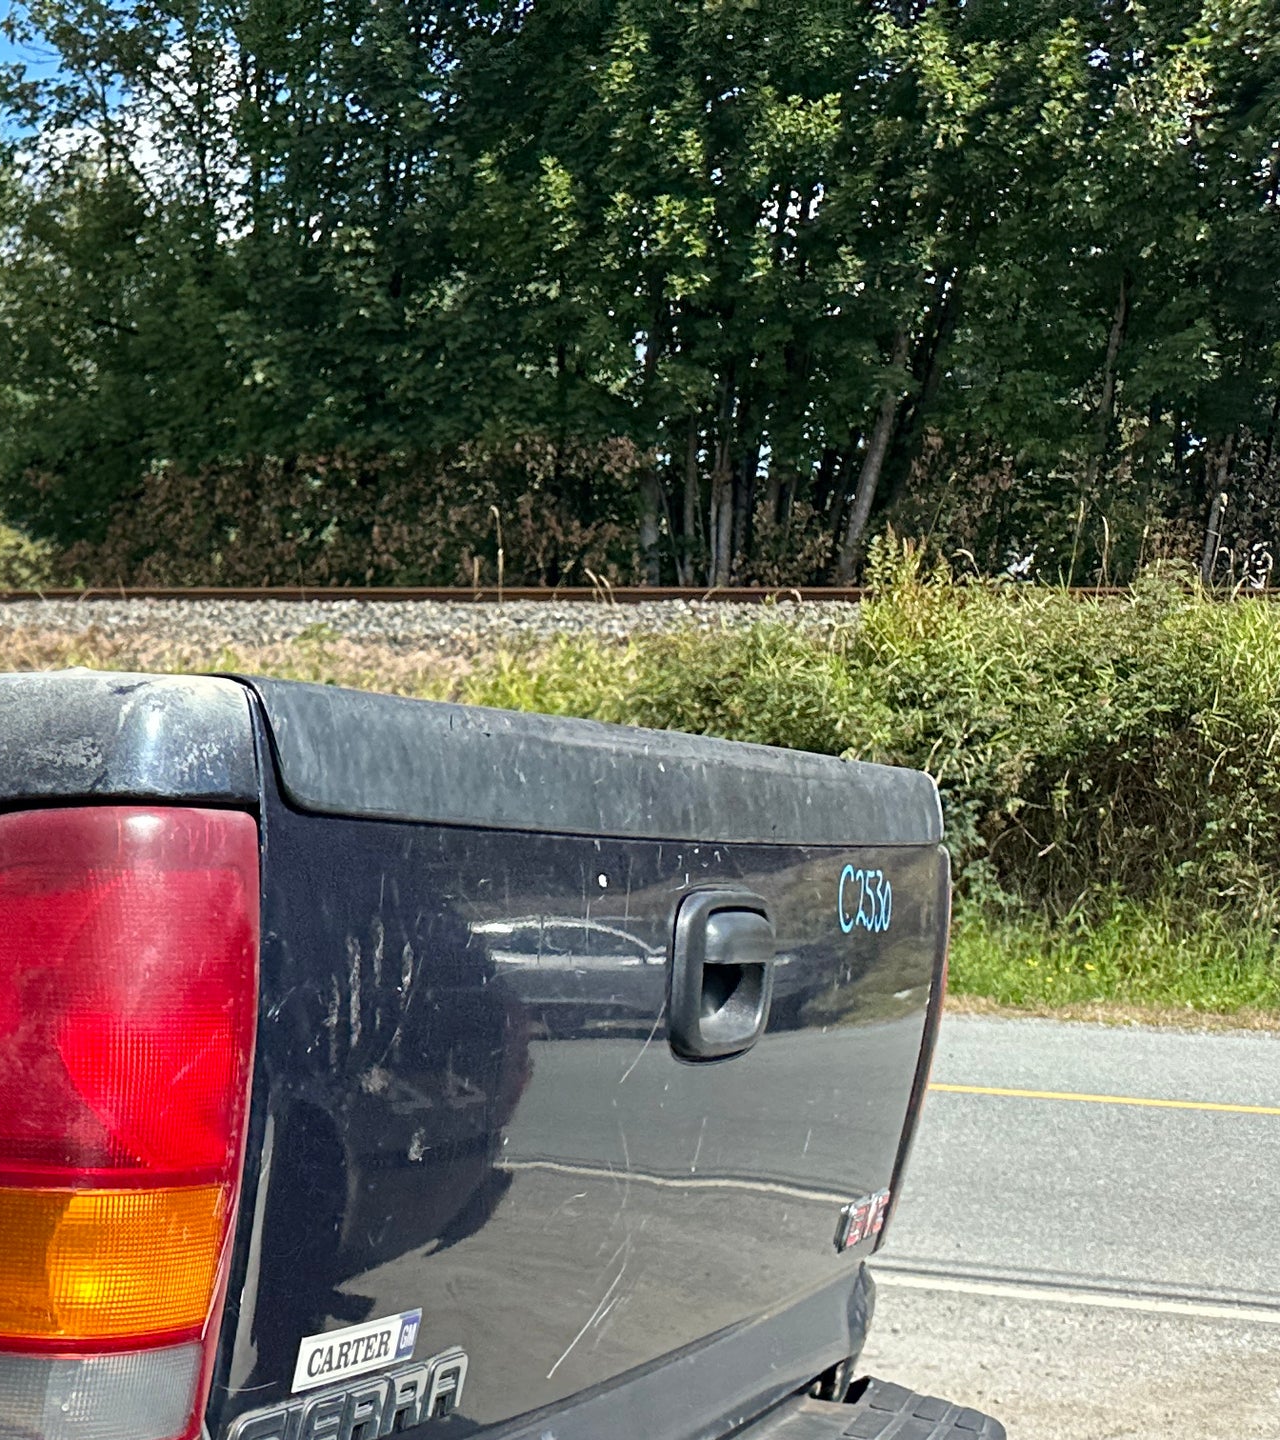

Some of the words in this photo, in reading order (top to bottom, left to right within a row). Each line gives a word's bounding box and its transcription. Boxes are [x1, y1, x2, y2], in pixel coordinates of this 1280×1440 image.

[838, 864, 892, 933] C2530
[306, 1330, 393, 1378] CARTER
[399, 1322, 417, 1350] GM
